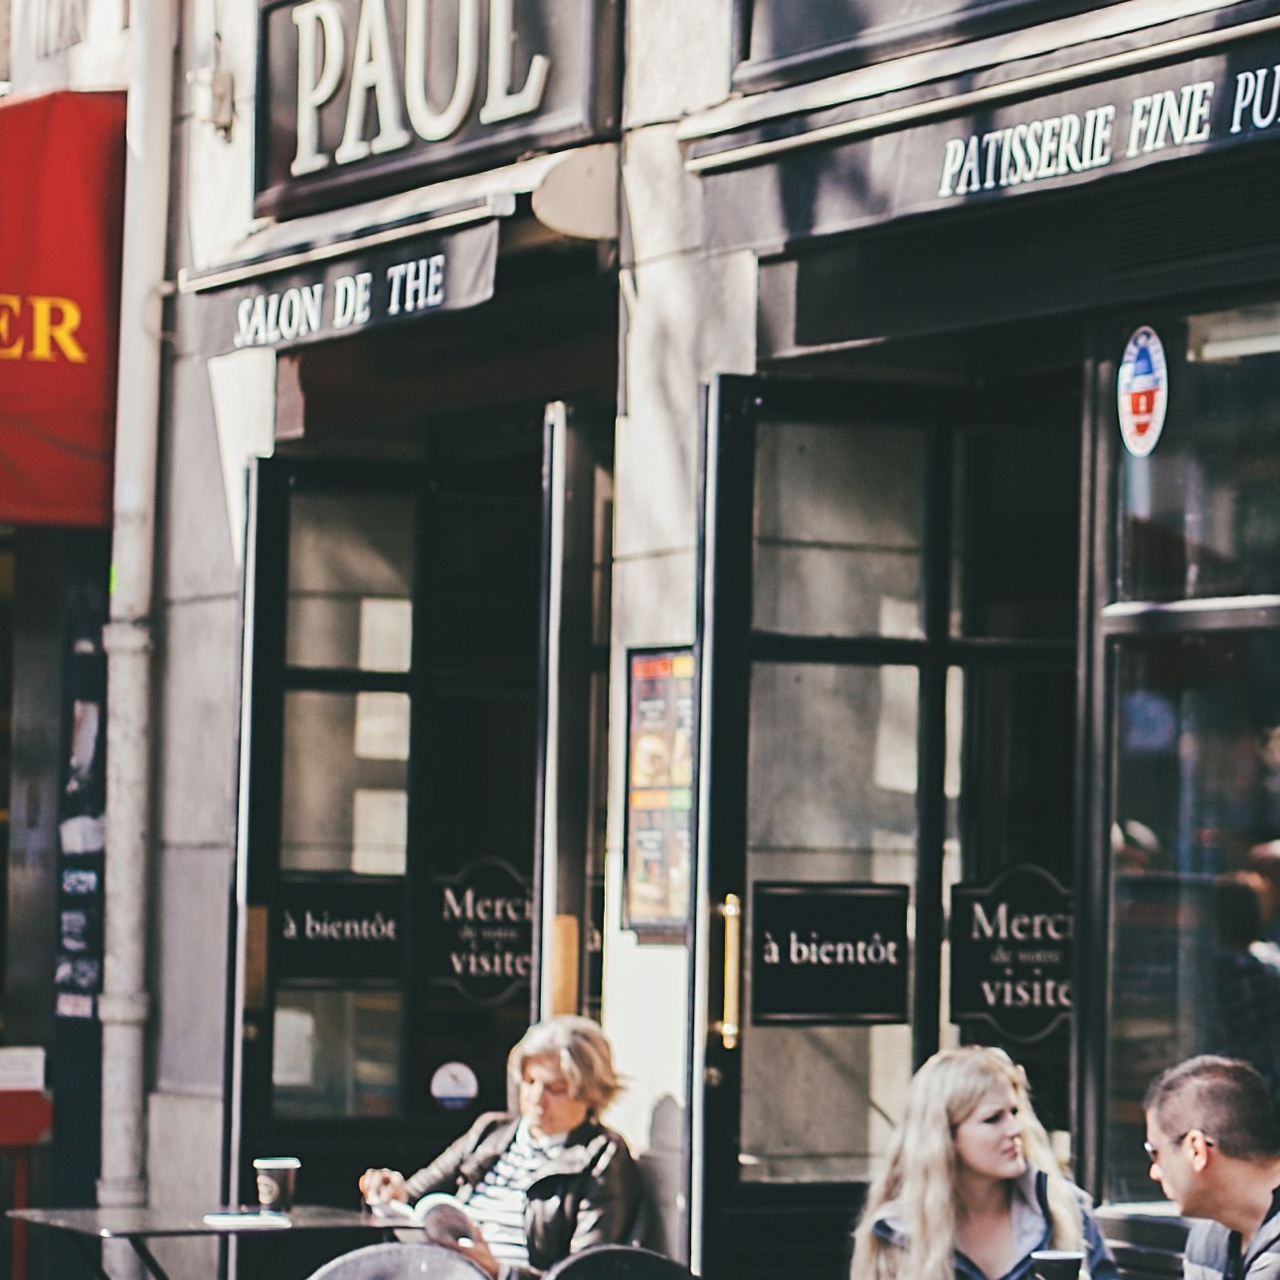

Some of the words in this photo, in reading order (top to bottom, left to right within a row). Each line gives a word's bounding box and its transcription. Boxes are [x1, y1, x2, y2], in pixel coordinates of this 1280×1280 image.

[938, 104, 1118, 198] PATISSERIE
[1126, 80, 1216, 159] FINE
[234, 283, 324, 349] SALON
[334, 272, 373, 329] DE
[387, 254, 446, 316] THE
[283, 910, 297, 942] à
[304, 910, 398, 942] bientôt
[763, 931, 780, 964] à
[790, 931, 898, 965] bientôt
